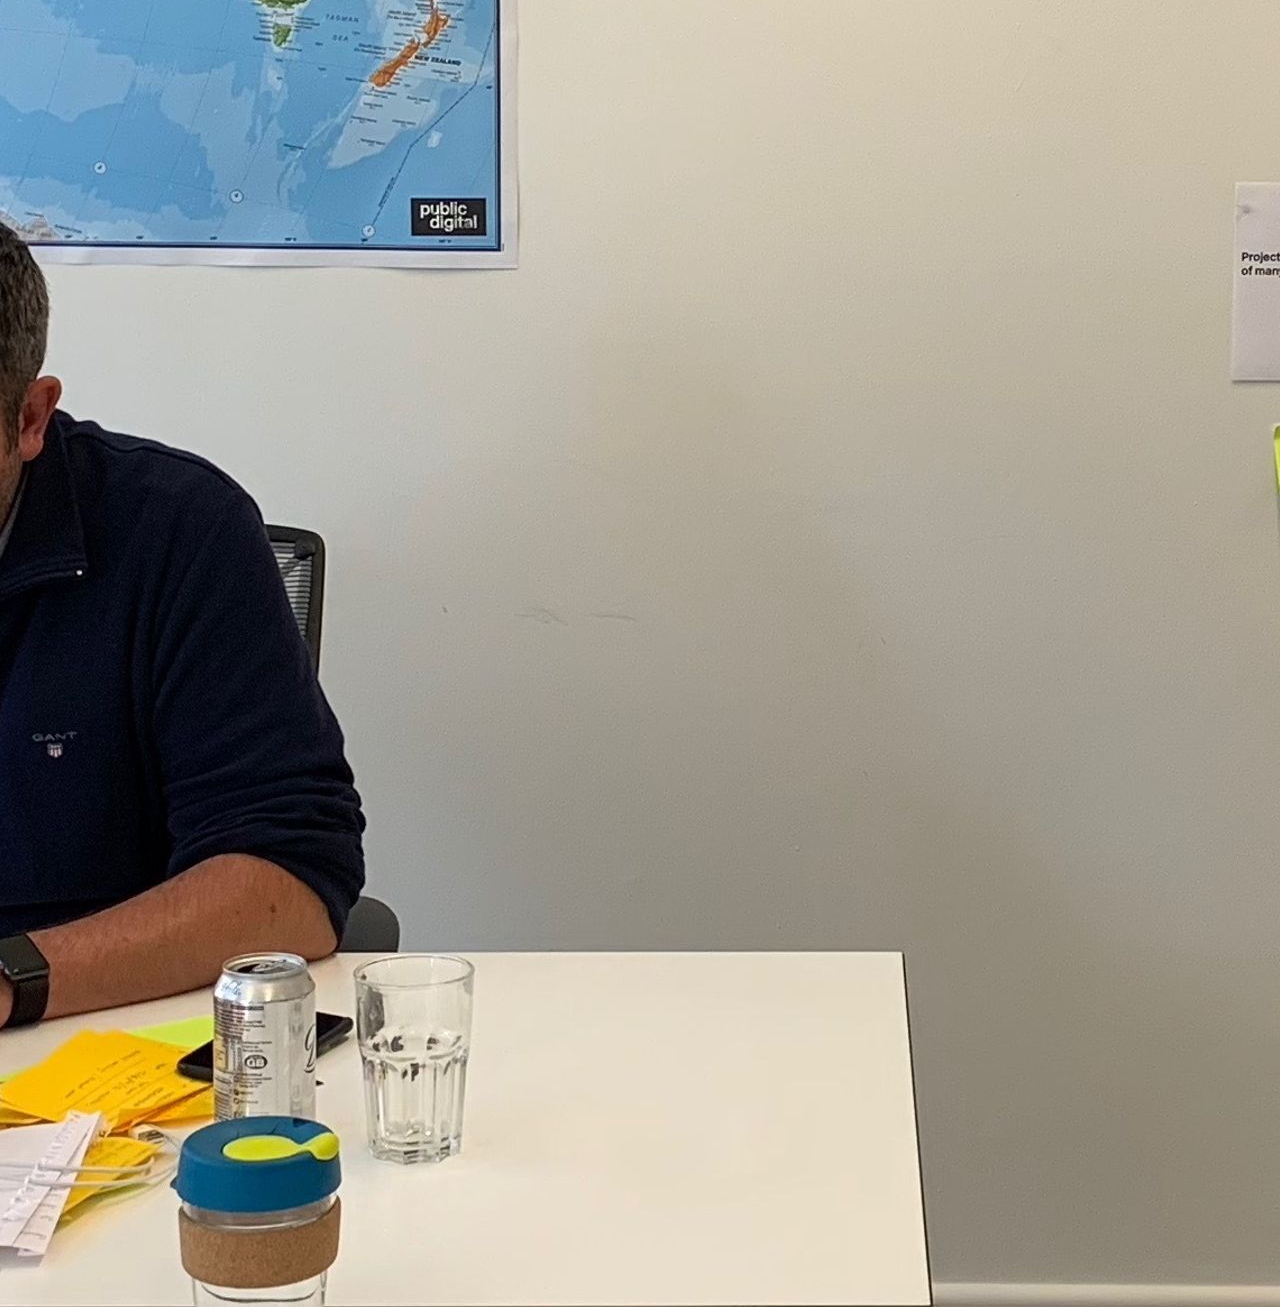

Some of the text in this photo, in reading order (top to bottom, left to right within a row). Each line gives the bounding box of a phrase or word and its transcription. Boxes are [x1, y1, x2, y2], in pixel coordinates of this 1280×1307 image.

[431, 57, 462, 67] ZEALAND
[420, 201, 468, 221] public
[429, 214, 478, 232] digital
[1241, 265, 1253, 276] of
[31, 731, 78, 743] GANT
